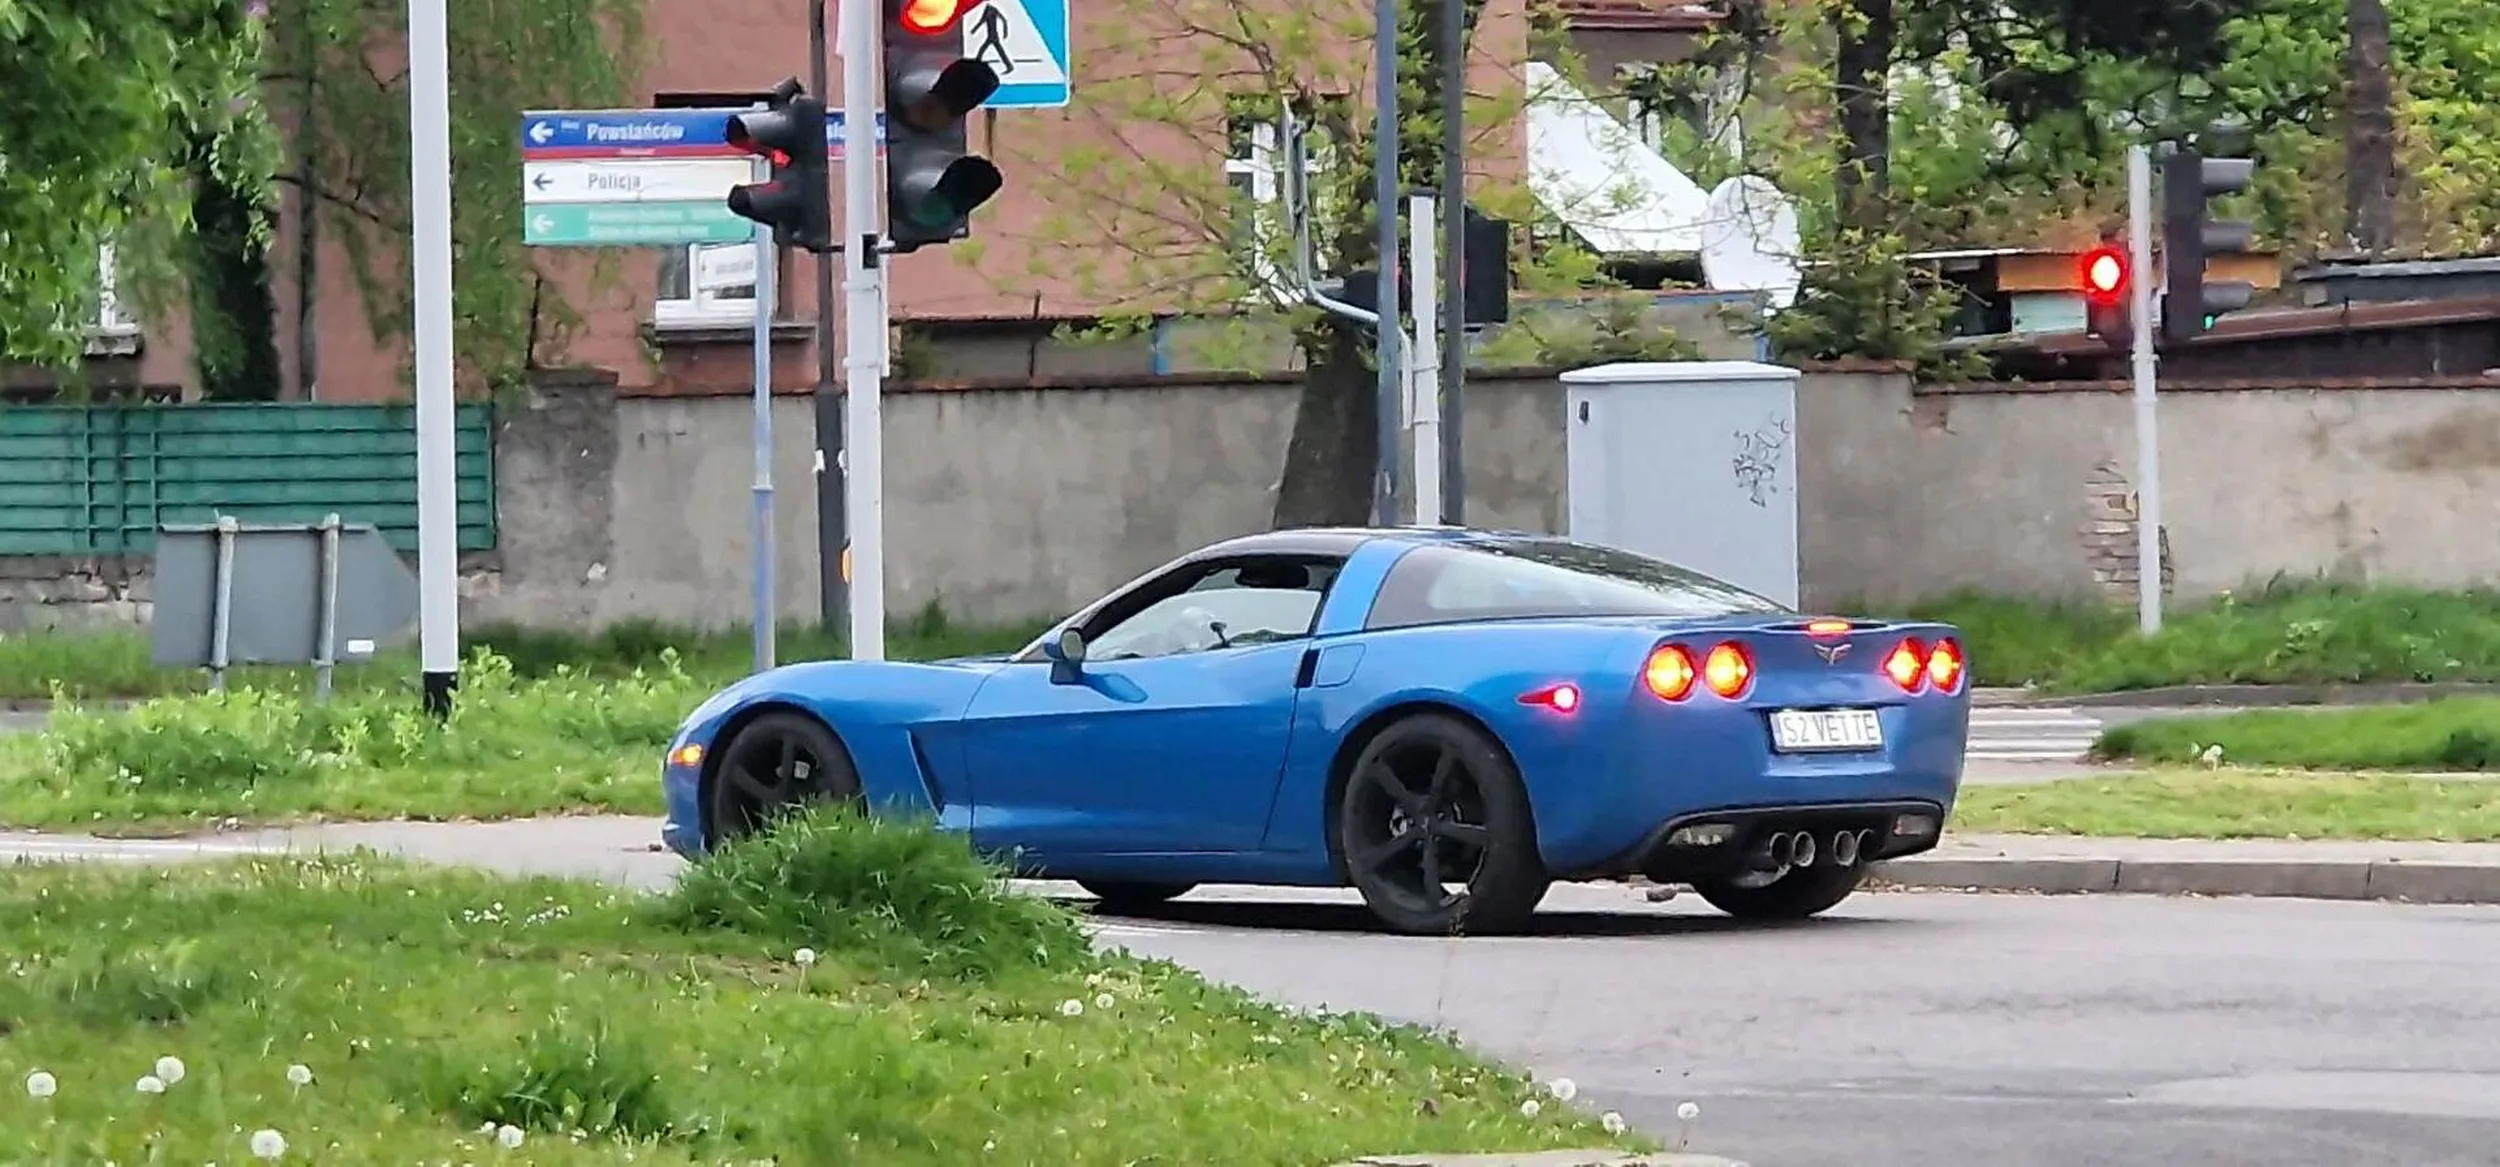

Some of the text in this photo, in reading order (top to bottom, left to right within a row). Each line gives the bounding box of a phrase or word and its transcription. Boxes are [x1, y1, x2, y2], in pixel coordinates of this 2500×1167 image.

[587, 121, 684, 141] Powstańców
[588, 172, 641, 192] Policja
[1782, 712, 1879, 743] S2 VETTE
